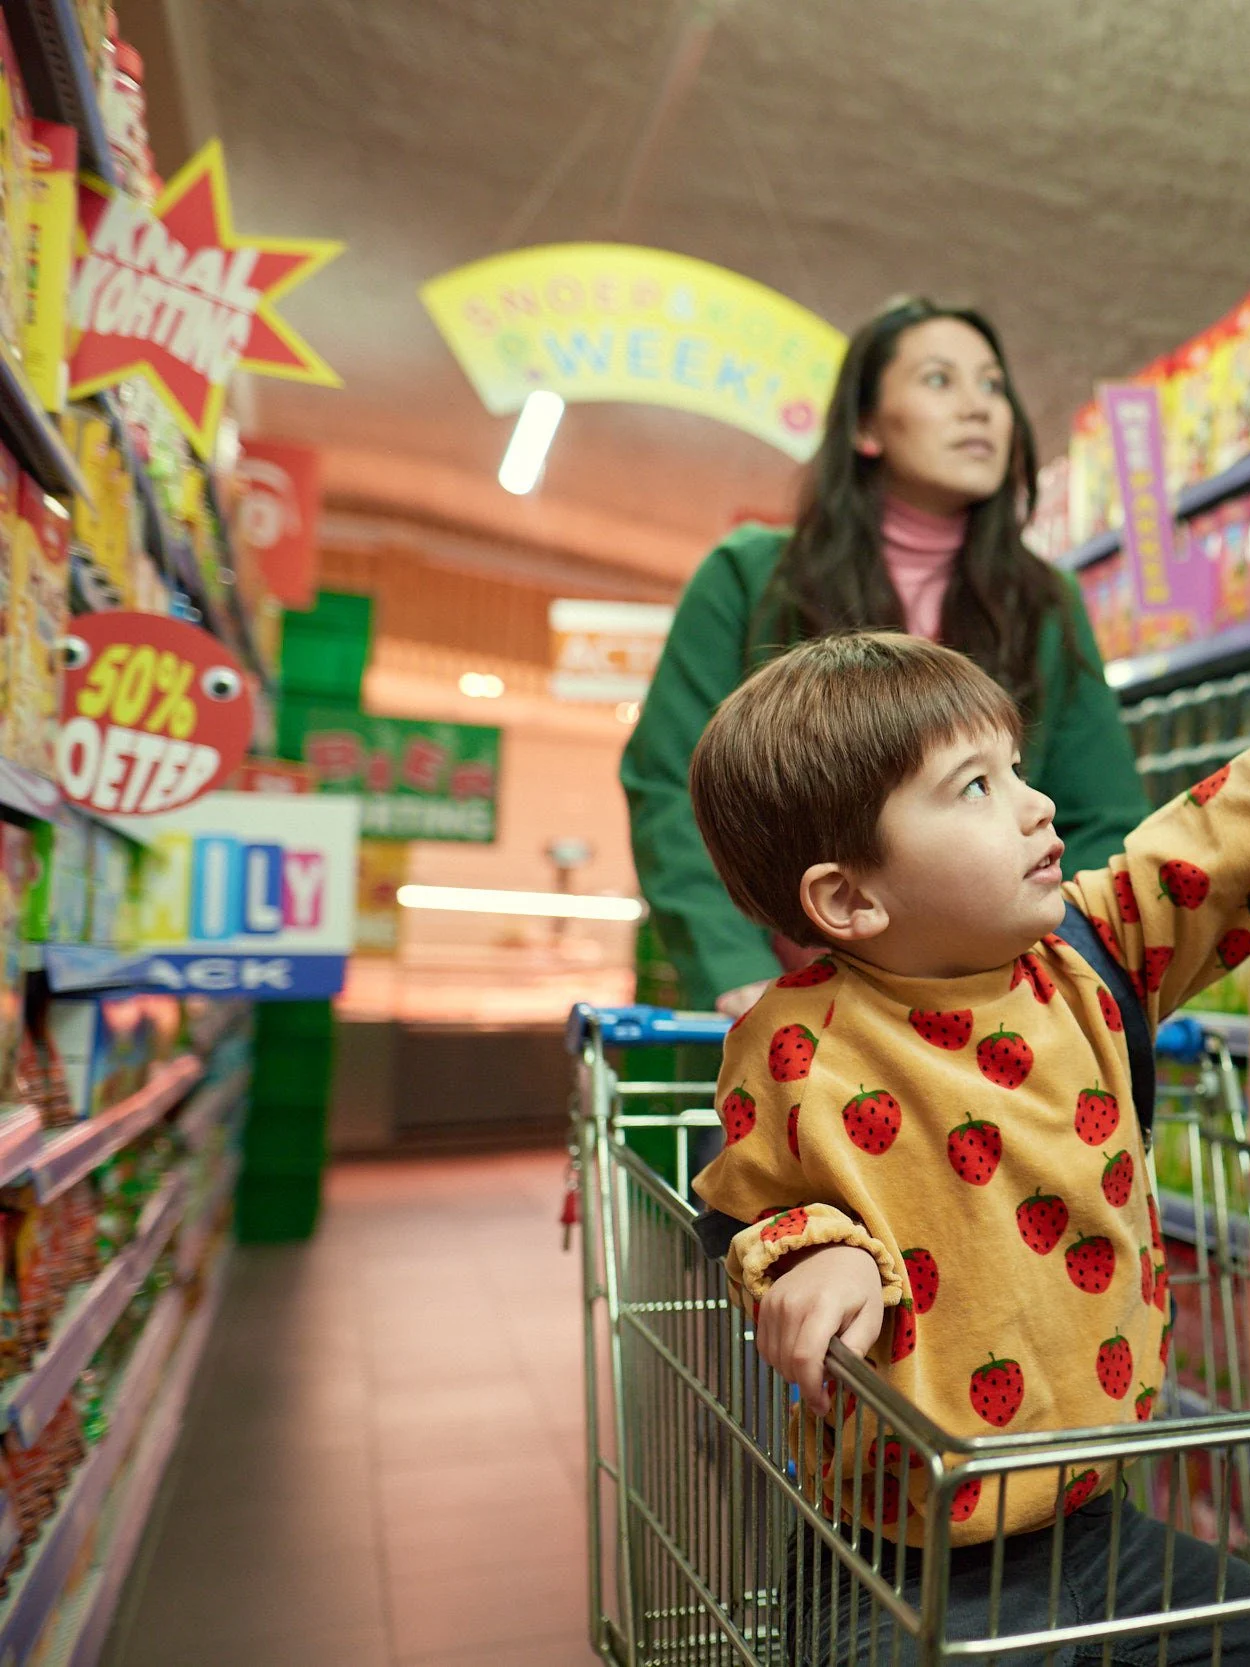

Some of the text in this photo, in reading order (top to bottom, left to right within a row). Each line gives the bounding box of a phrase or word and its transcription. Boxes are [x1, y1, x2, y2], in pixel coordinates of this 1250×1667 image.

[92, 190, 260, 316] KNAL
[70, 254, 252, 384] KORTING
[77, 643, 198, 740] 50%
